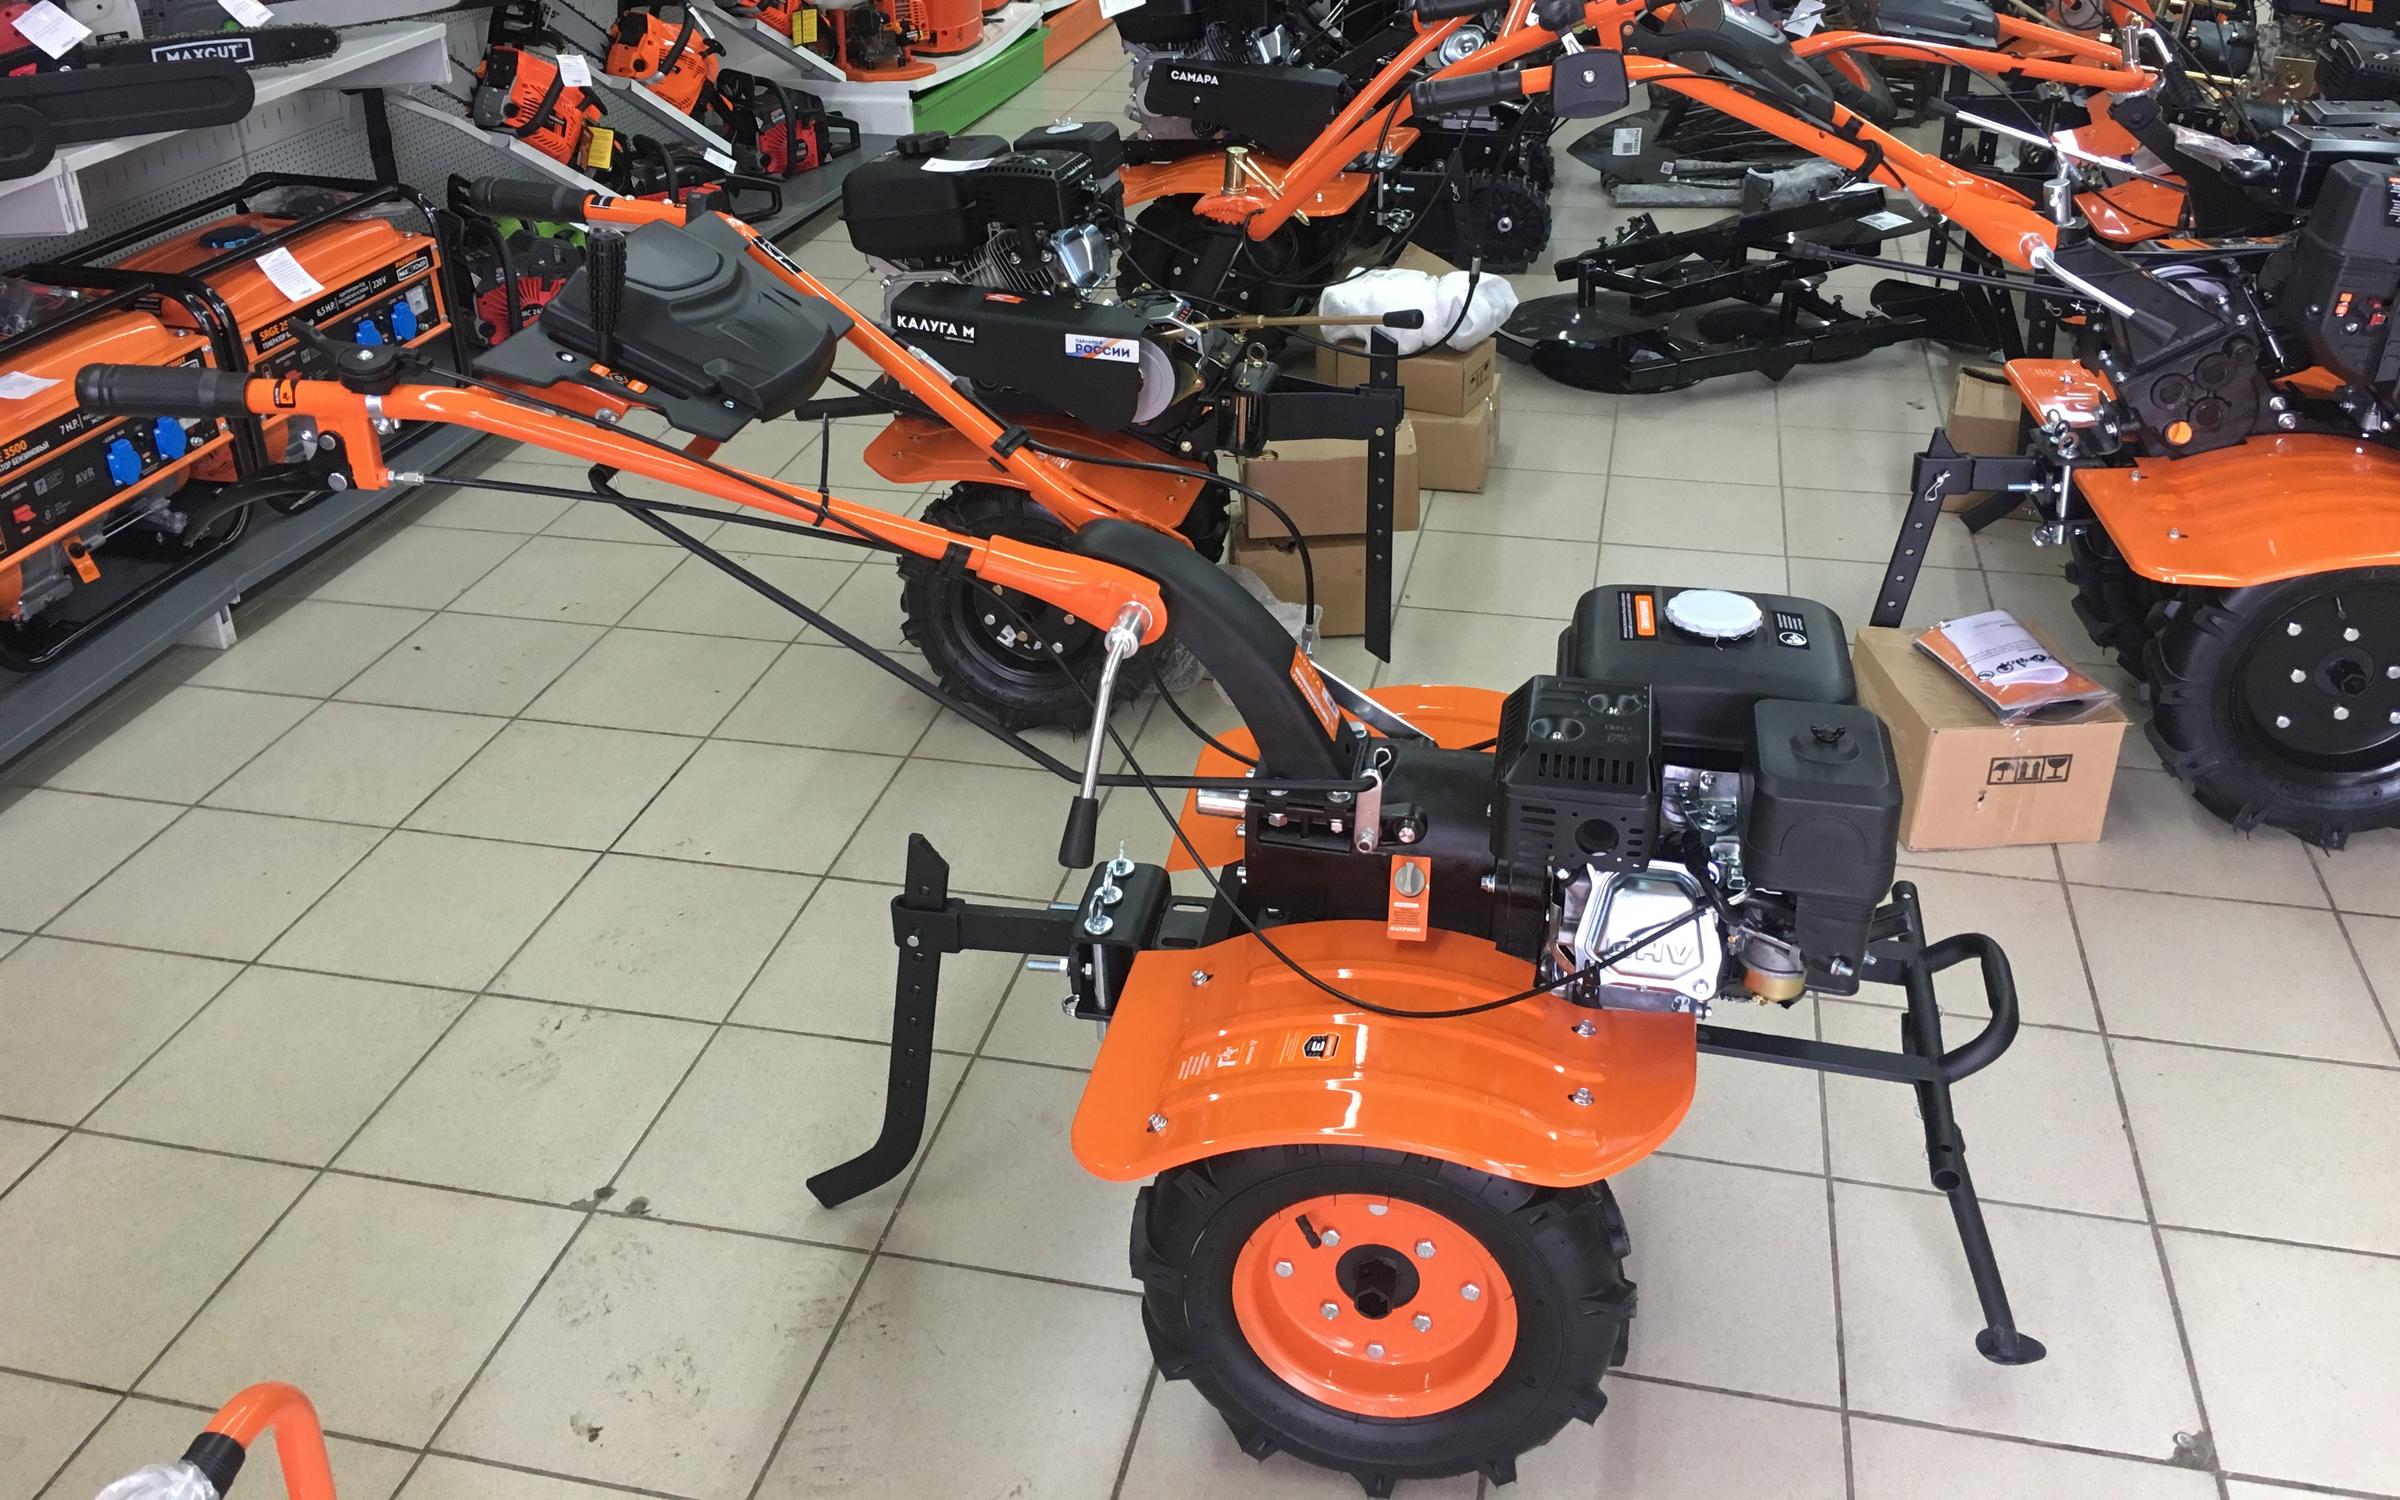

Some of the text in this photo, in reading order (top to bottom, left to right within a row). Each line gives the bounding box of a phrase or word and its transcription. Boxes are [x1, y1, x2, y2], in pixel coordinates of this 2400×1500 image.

[166, 44, 238, 61] MAXCUT
[1170, 70, 1219, 85] САМАРА
[897, 315, 975, 339] КАЛУГА М
[1075, 343, 1131, 358] РОССИИ
[4, 440, 28, 460] 3500
[75, 467, 96, 485] AVR
